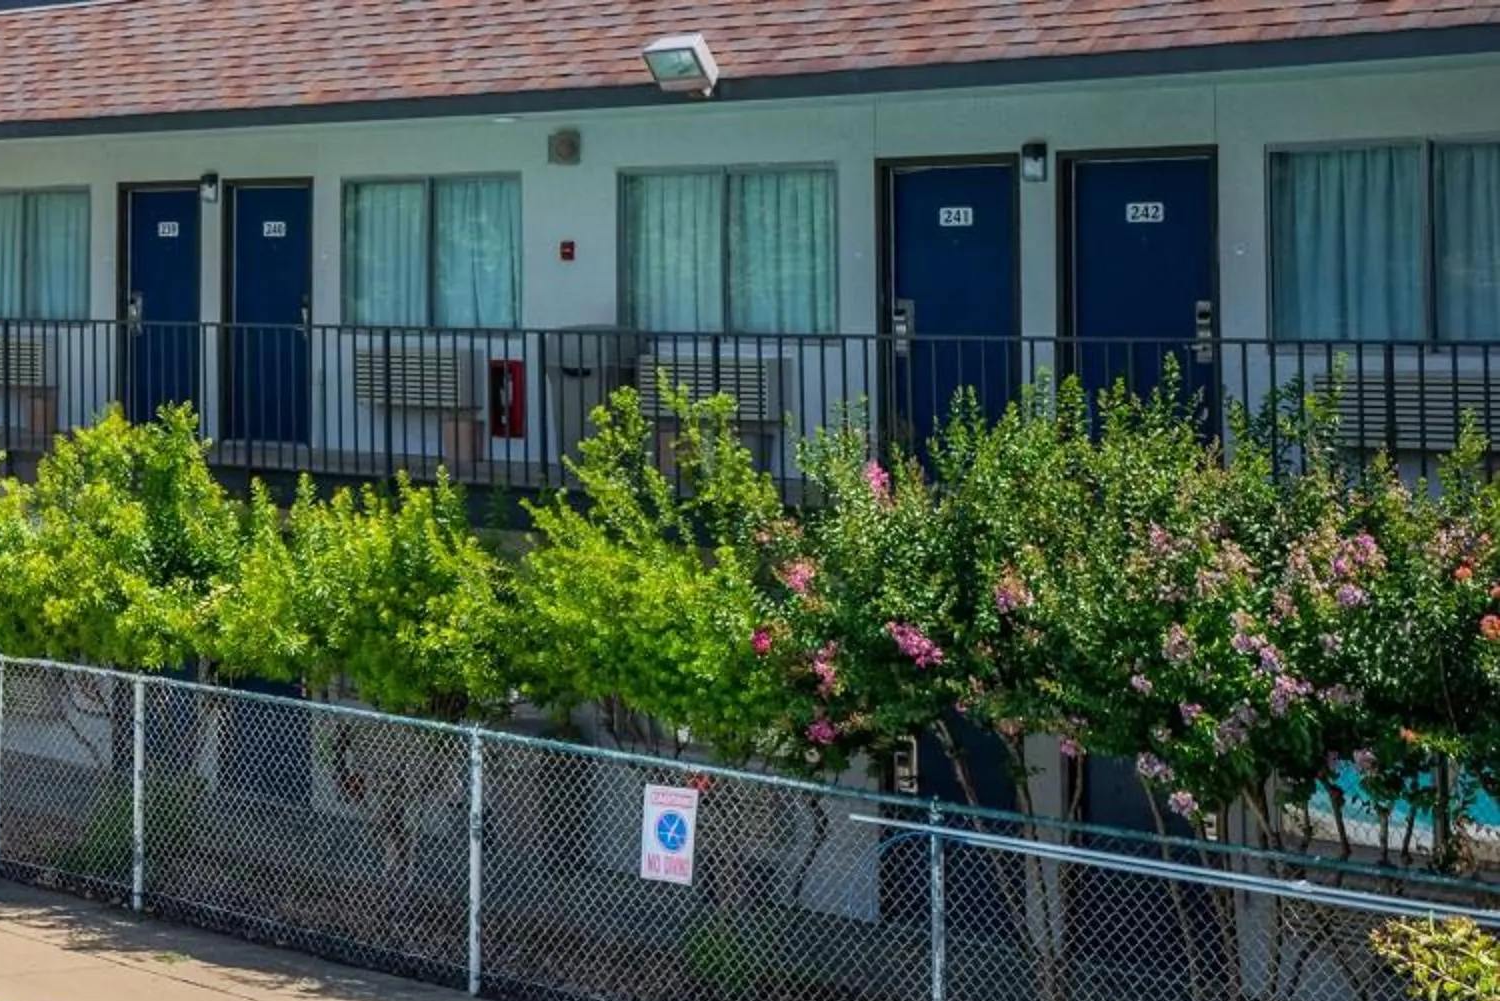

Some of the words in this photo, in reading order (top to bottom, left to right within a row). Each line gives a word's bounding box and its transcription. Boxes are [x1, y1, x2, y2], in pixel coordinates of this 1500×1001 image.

[944, 209, 969, 225] 241
[1130, 204, 1160, 221] 242
[265, 223, 284, 235] 240
[647, 853, 660, 875] NO
